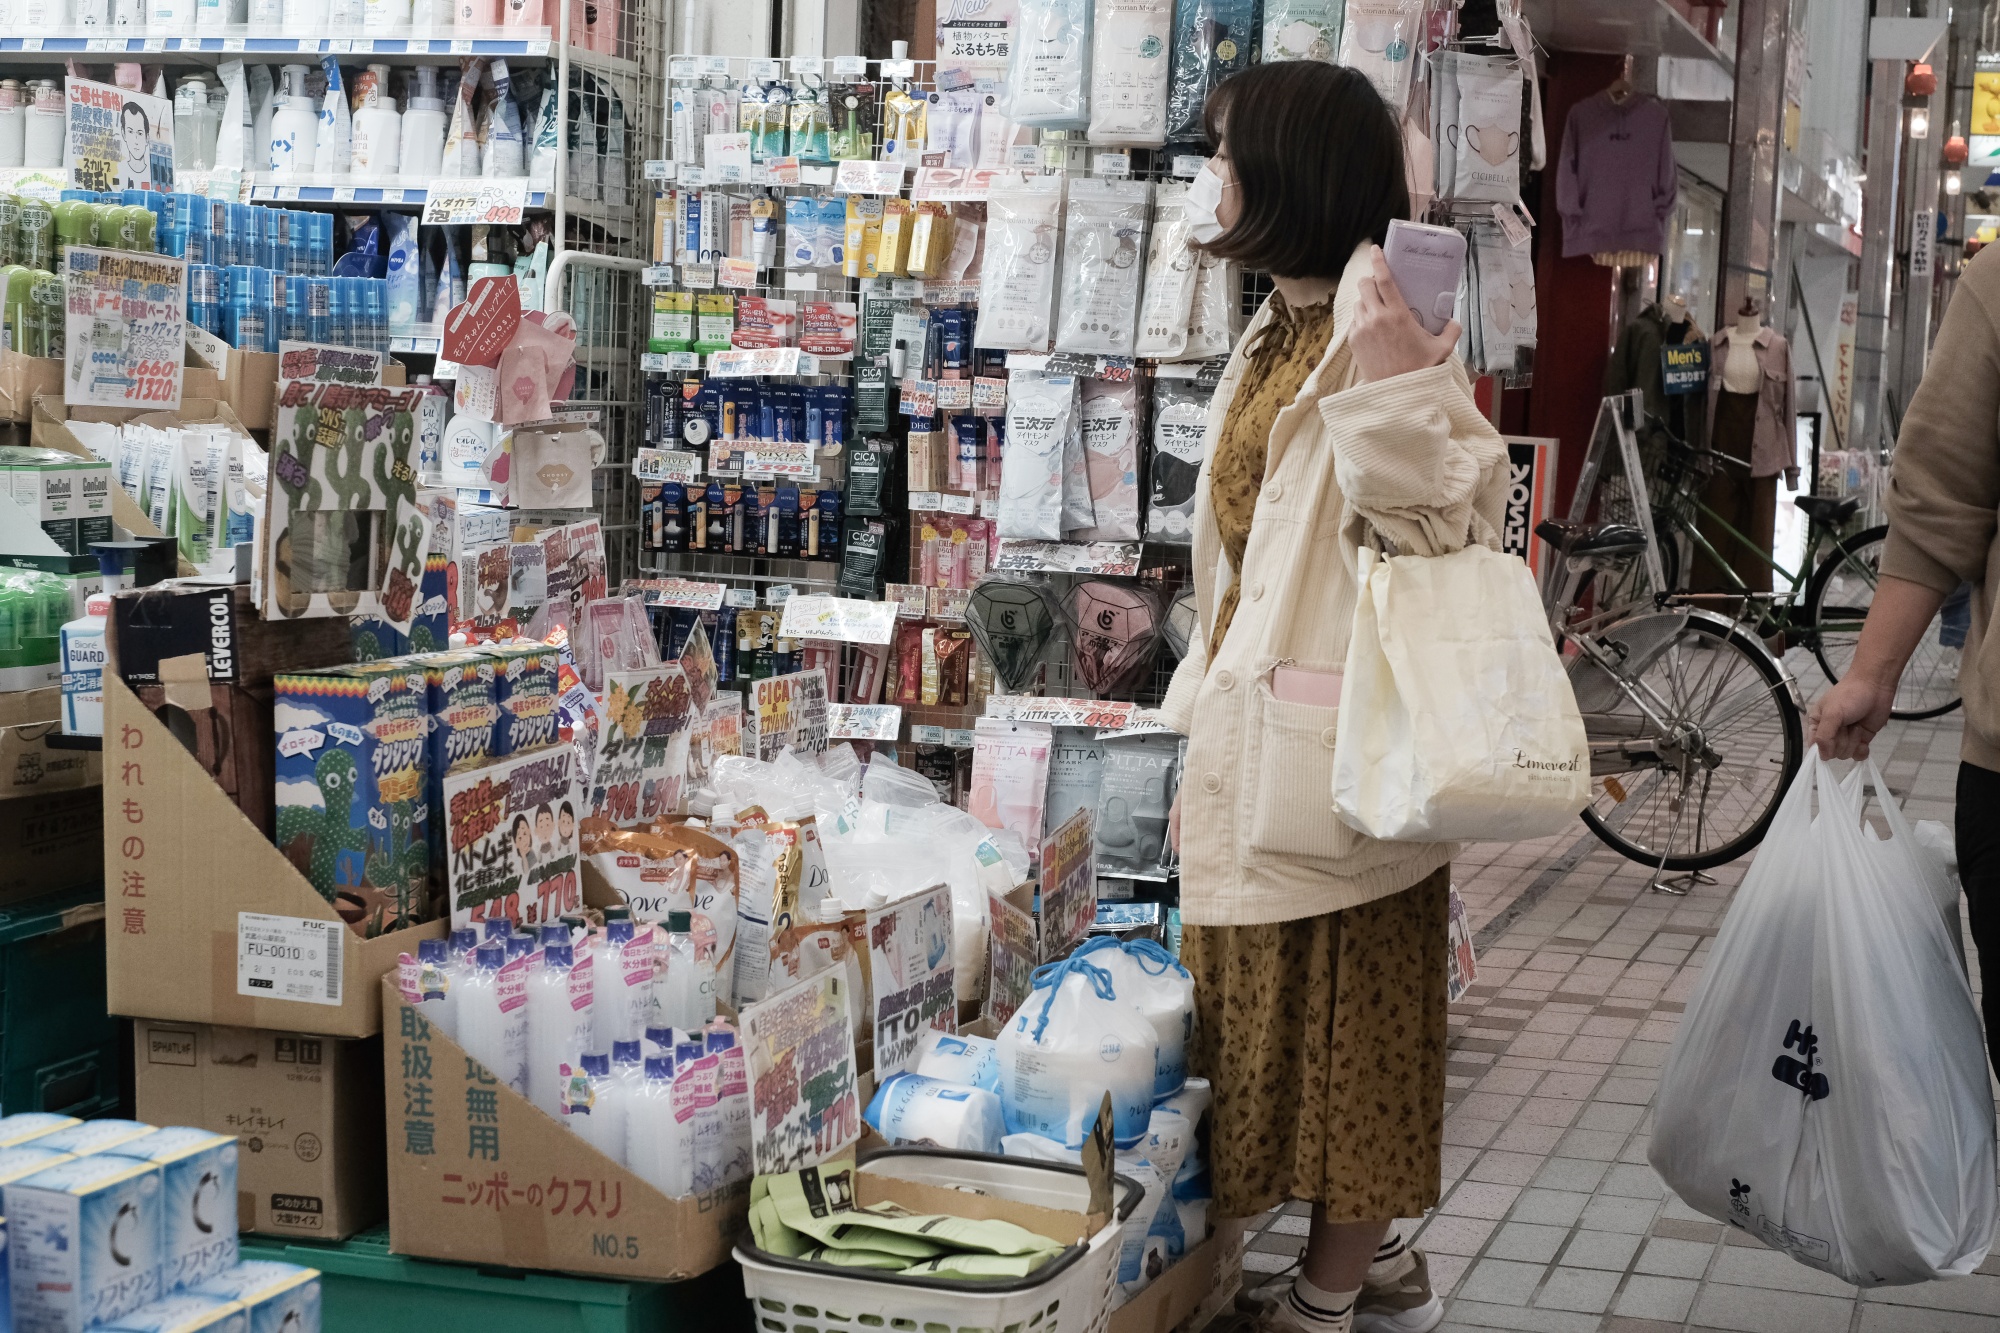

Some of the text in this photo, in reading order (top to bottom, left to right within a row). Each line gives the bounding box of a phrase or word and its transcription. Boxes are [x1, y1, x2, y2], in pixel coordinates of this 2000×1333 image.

[952, 31, 1009, 41] 植物バターで
[951, 43, 1009, 57] ぷるもち唇
[83, 158, 111, 172] スカルプ
[925, 158, 941, 166] 復活!
[1471, 171, 1511, 184] CICIBELLA
[430, 199, 477, 208] ハダカラ
[23, 210, 49, 221] 敏感肌
[427, 209, 450, 222] 泡
[482, 278, 512, 319] リップケア
[129, 319, 182, 335] チェックアップ
[479, 313, 512, 351] CHOOSY
[130, 334, 180, 348] スタンダード
[134, 349, 169, 361] ハミガキ
[205, 345, 216, 353] 30
[1667, 348, 1702, 365] Men's
[1051, 352, 1098, 366] 三次元
[861, 368, 881, 377] CICA
[1013, 417, 1056, 431] 三次元
[1082, 417, 1122, 432] 三次元
[1160, 424, 1206, 438] 三次元
[1016, 432, 1050, 440] ダイヤモンド
[1084, 433, 1117, 441] ダイヤモンド
[1164, 439, 1201, 447] ダイヤモンド
[854, 453, 876, 461] CICA
[276, 452, 307, 488] 踊る
[392, 460, 418, 485] 光る!!
[46, 478, 72, 494] ConCool
[83, 476, 107, 492] ConCool
[852, 533, 875, 542] CICA
[209, 594, 233, 678] LEVERCOL
[1081, 631, 1124, 647] アースカラー
[75, 640, 98, 649] Bioré
[70, 650, 104, 662] GUARD
[645, 675, 686, 698] 大人気
[757, 680, 790, 705] CICA
[512, 697, 554, 713] 陽気なサボテン
[449, 707, 491, 725] 陽気なサボテン
[1019, 711, 1084, 721] PITTAマスク
[1083, 713, 1128, 728] 498
[331, 725, 361, 741] ものまね
[376, 719, 422, 738] 陽気なサボテン
[508, 712, 555, 750] ダンシング
[445, 723, 493, 764] ダンシング
[977, 744, 1028, 756] PITTA
[371, 737, 423, 778] ダンシング
[1105, 754, 1158, 769] PITTA
[378, 773, 420, 804] アミーゴ
[121, 724, 147, 935] われもの注意
[581, 833, 596, 841] 液体
[453, 829, 513, 875] ハトムギ
[455, 862, 514, 893] 化粧水
[777, 853, 790, 907] つめかえ用
[302, 921, 326, 930] FUC
[247, 943, 301, 960] FU-0010
[877, 1007, 920, 1049] ITO
[963, 1045, 978, 1062] ITO
[400, 1006, 436, 1156] 取扱注意
[926, 1086, 940, 1096] ITO
[226, 1114, 285, 1129] キレイキレイ
[441, 1172, 622, 1219] ニッポーのクスリ
[275, 1198, 318, 1211] つめかえ用
[276, 1213, 318, 1226] 大型サイズ
[593, 1234, 639, 1260] NO.5
